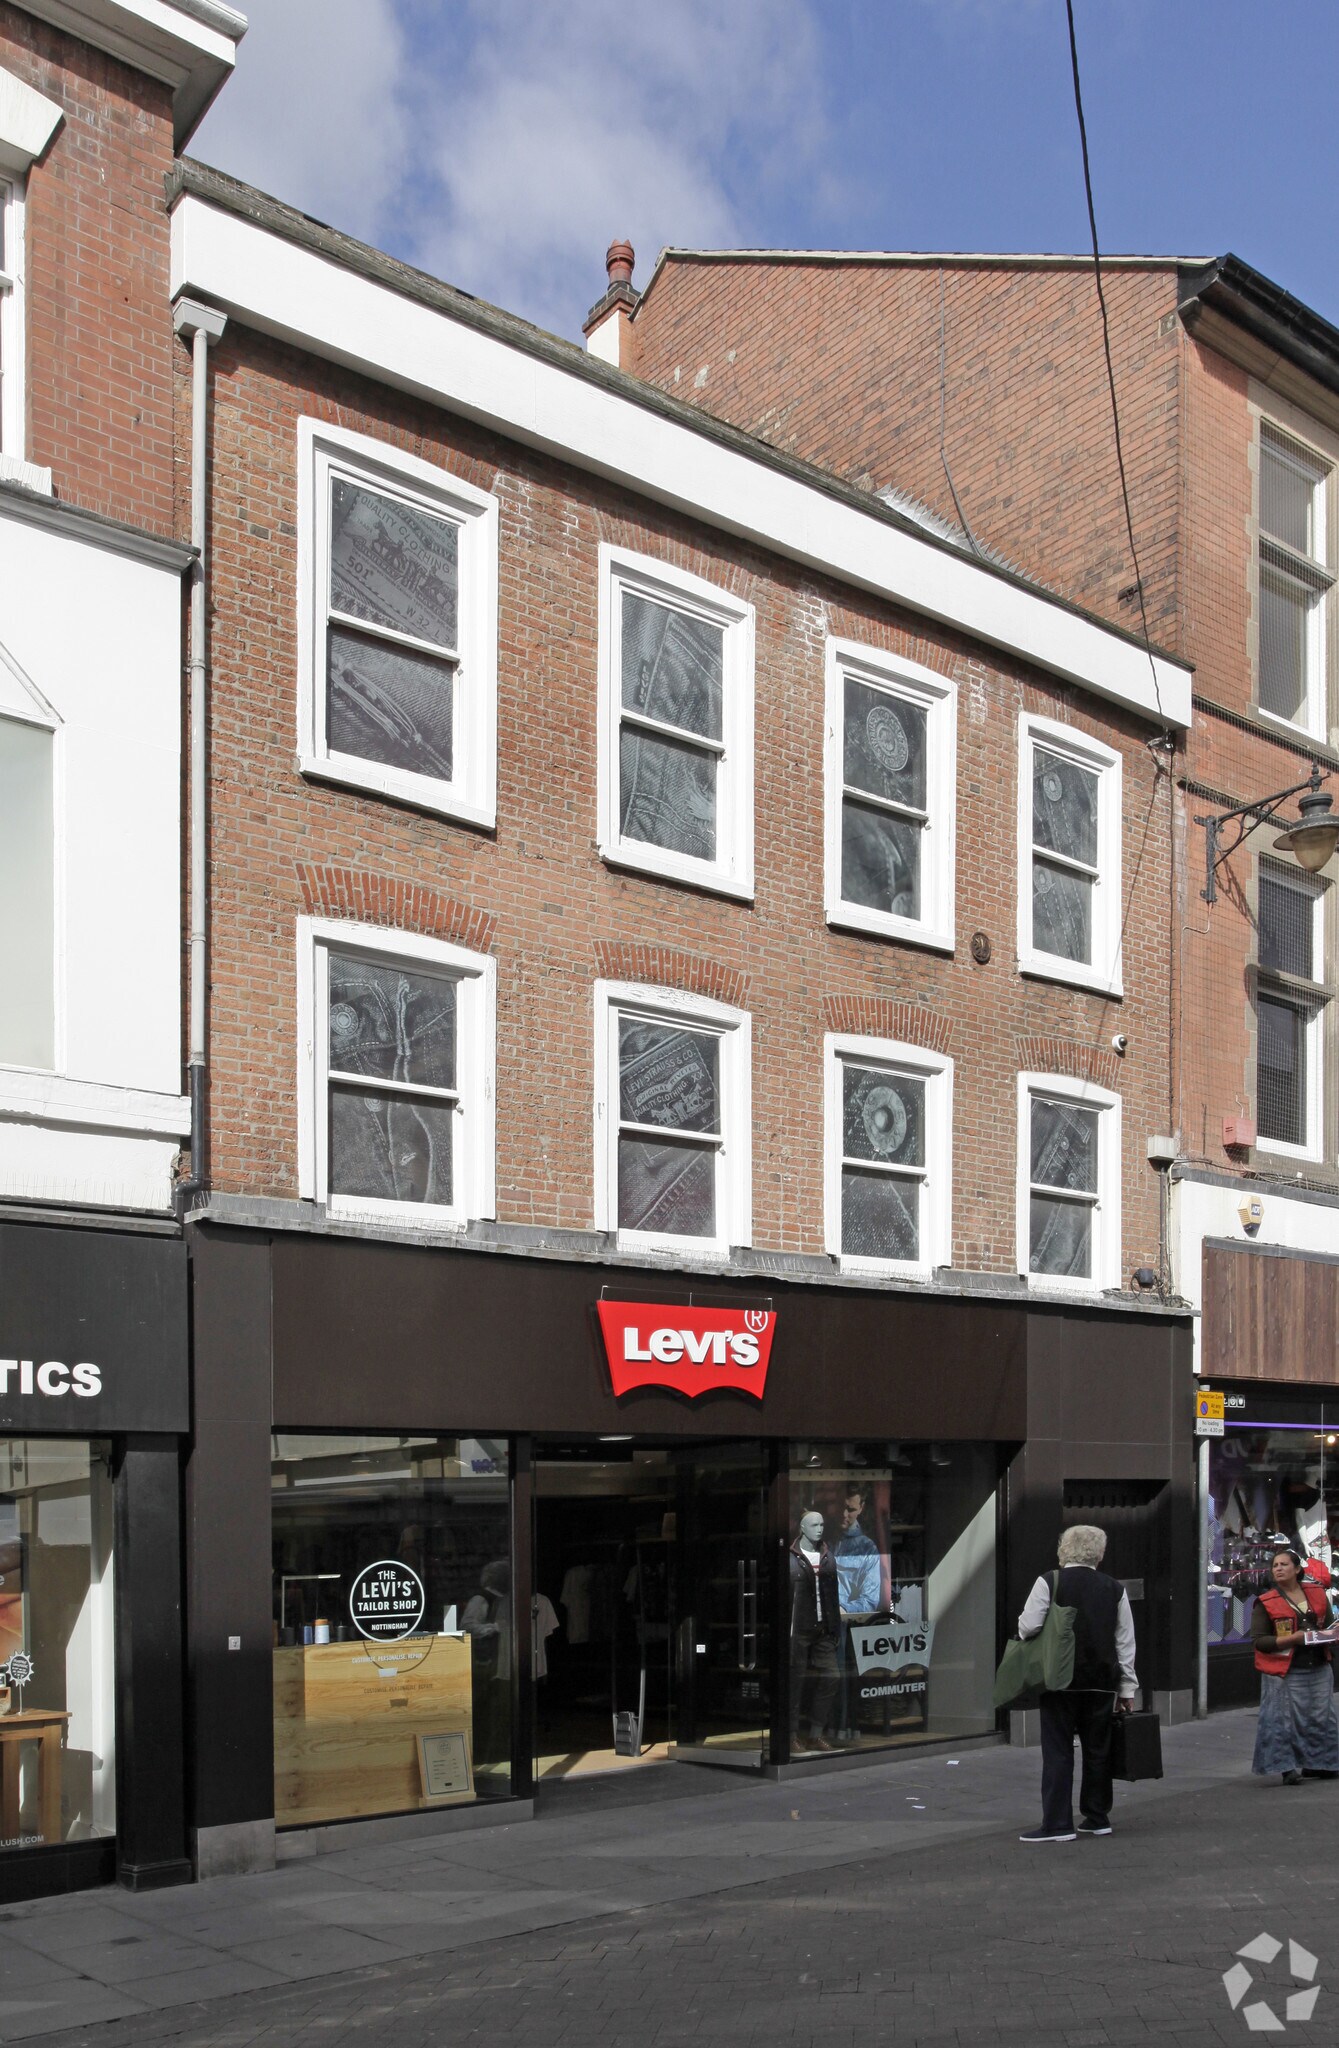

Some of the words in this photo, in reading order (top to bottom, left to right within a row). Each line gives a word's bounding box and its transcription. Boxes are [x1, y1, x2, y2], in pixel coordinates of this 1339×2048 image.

[360, 495, 397, 529] QUALITY
[406, 606, 416, 617] W
[625, 1077, 644, 1094] LEVI
[645, 1058, 676, 1083] STRAUSS
[377, 1570, 397, 1580] THE
[357, 1601, 390, 1611] TAILOR
[393, 1600, 418, 1610] SHOP
[371, 1622, 408, 1631] NOTTINGHAM
[860, 1681, 927, 1698] COMMUTER
[1, 1835, 44, 1846] LUSH.COM
